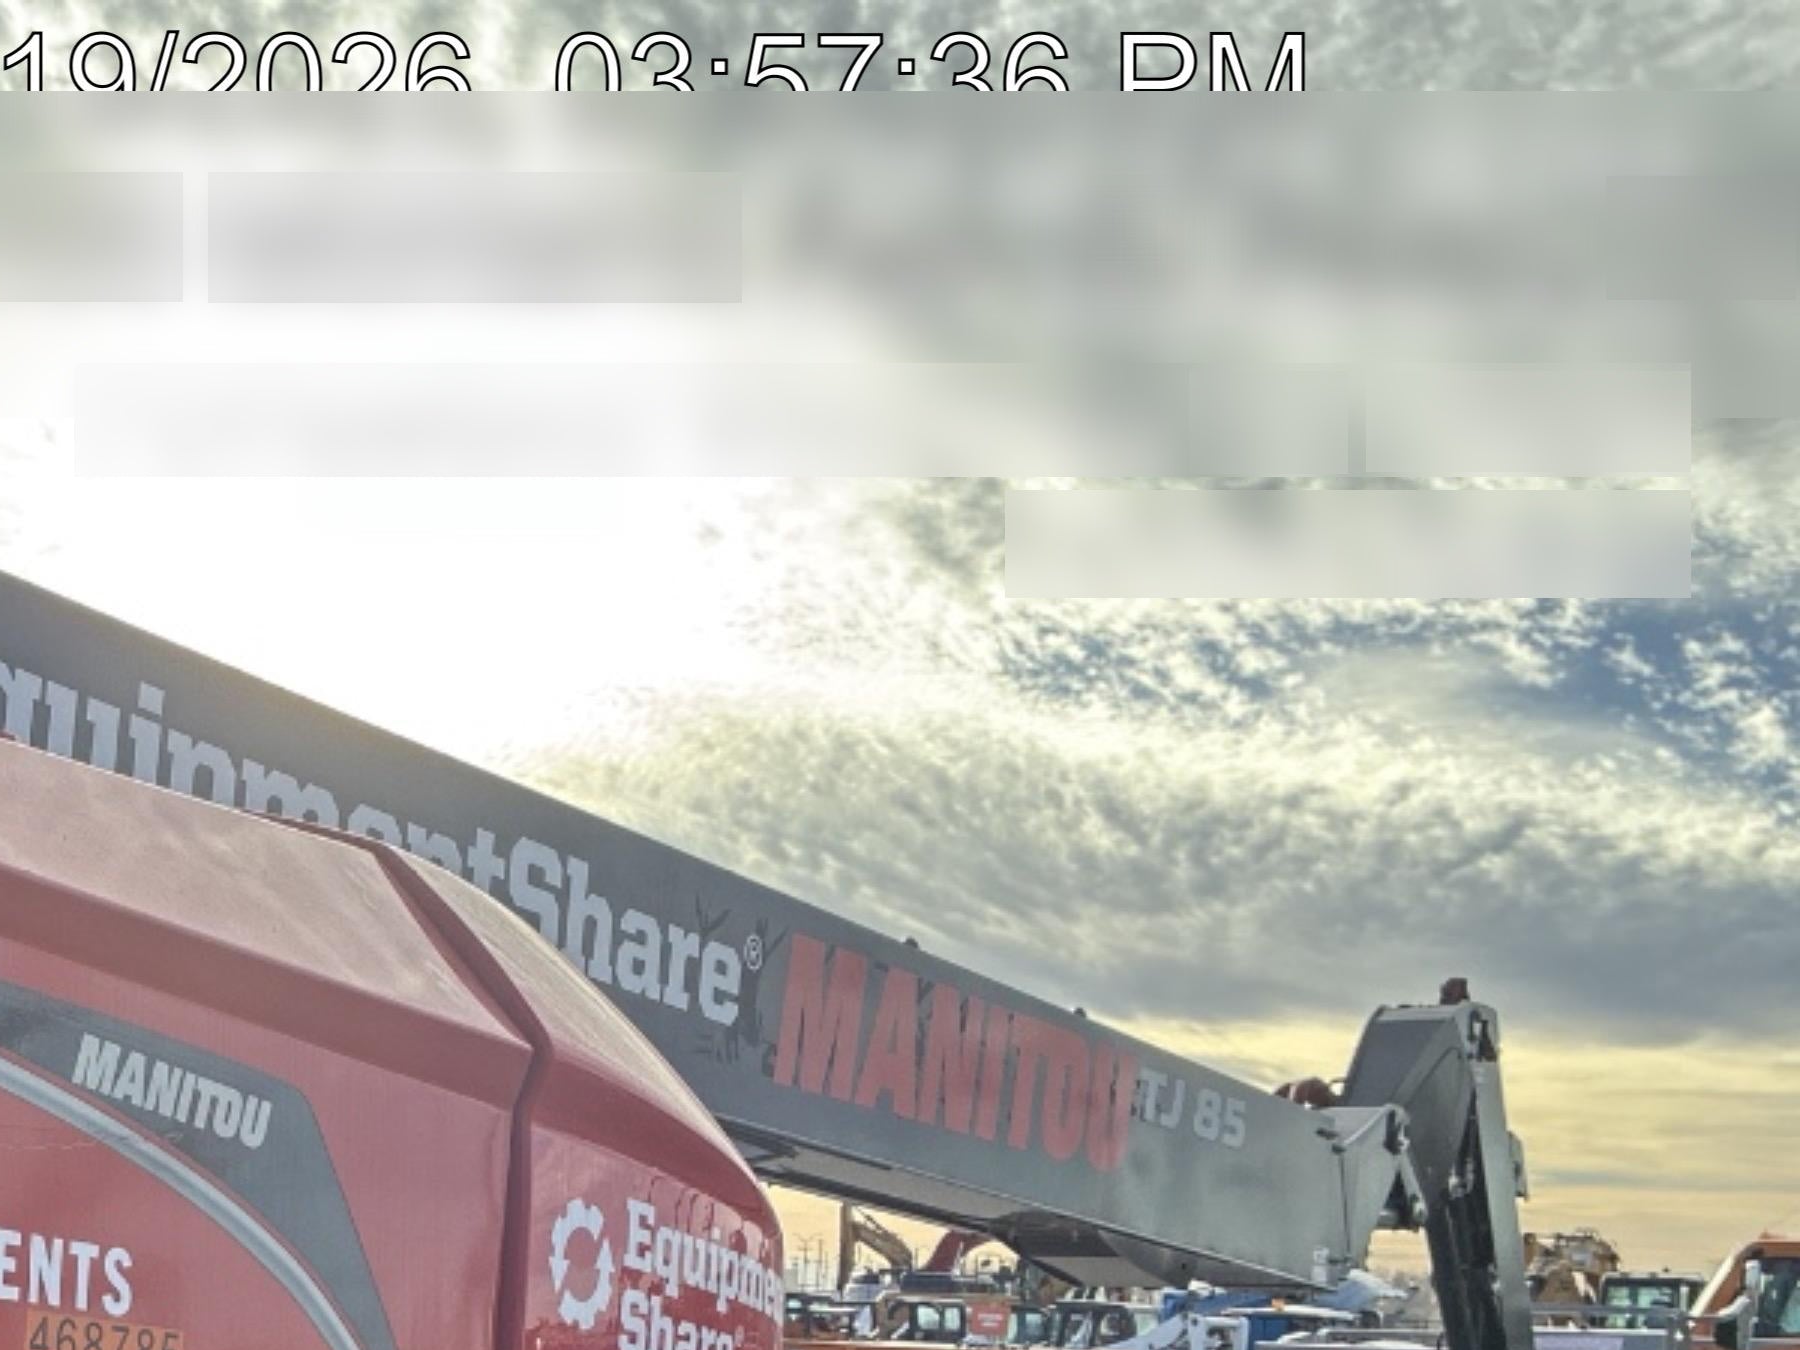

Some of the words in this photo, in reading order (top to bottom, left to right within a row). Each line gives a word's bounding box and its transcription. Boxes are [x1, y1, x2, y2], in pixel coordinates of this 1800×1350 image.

[72, 1032, 273, 1149] MANITOU
[774, 934, 1137, 1173] MANITOU
[1193, 1088, 1246, 1148] 85
